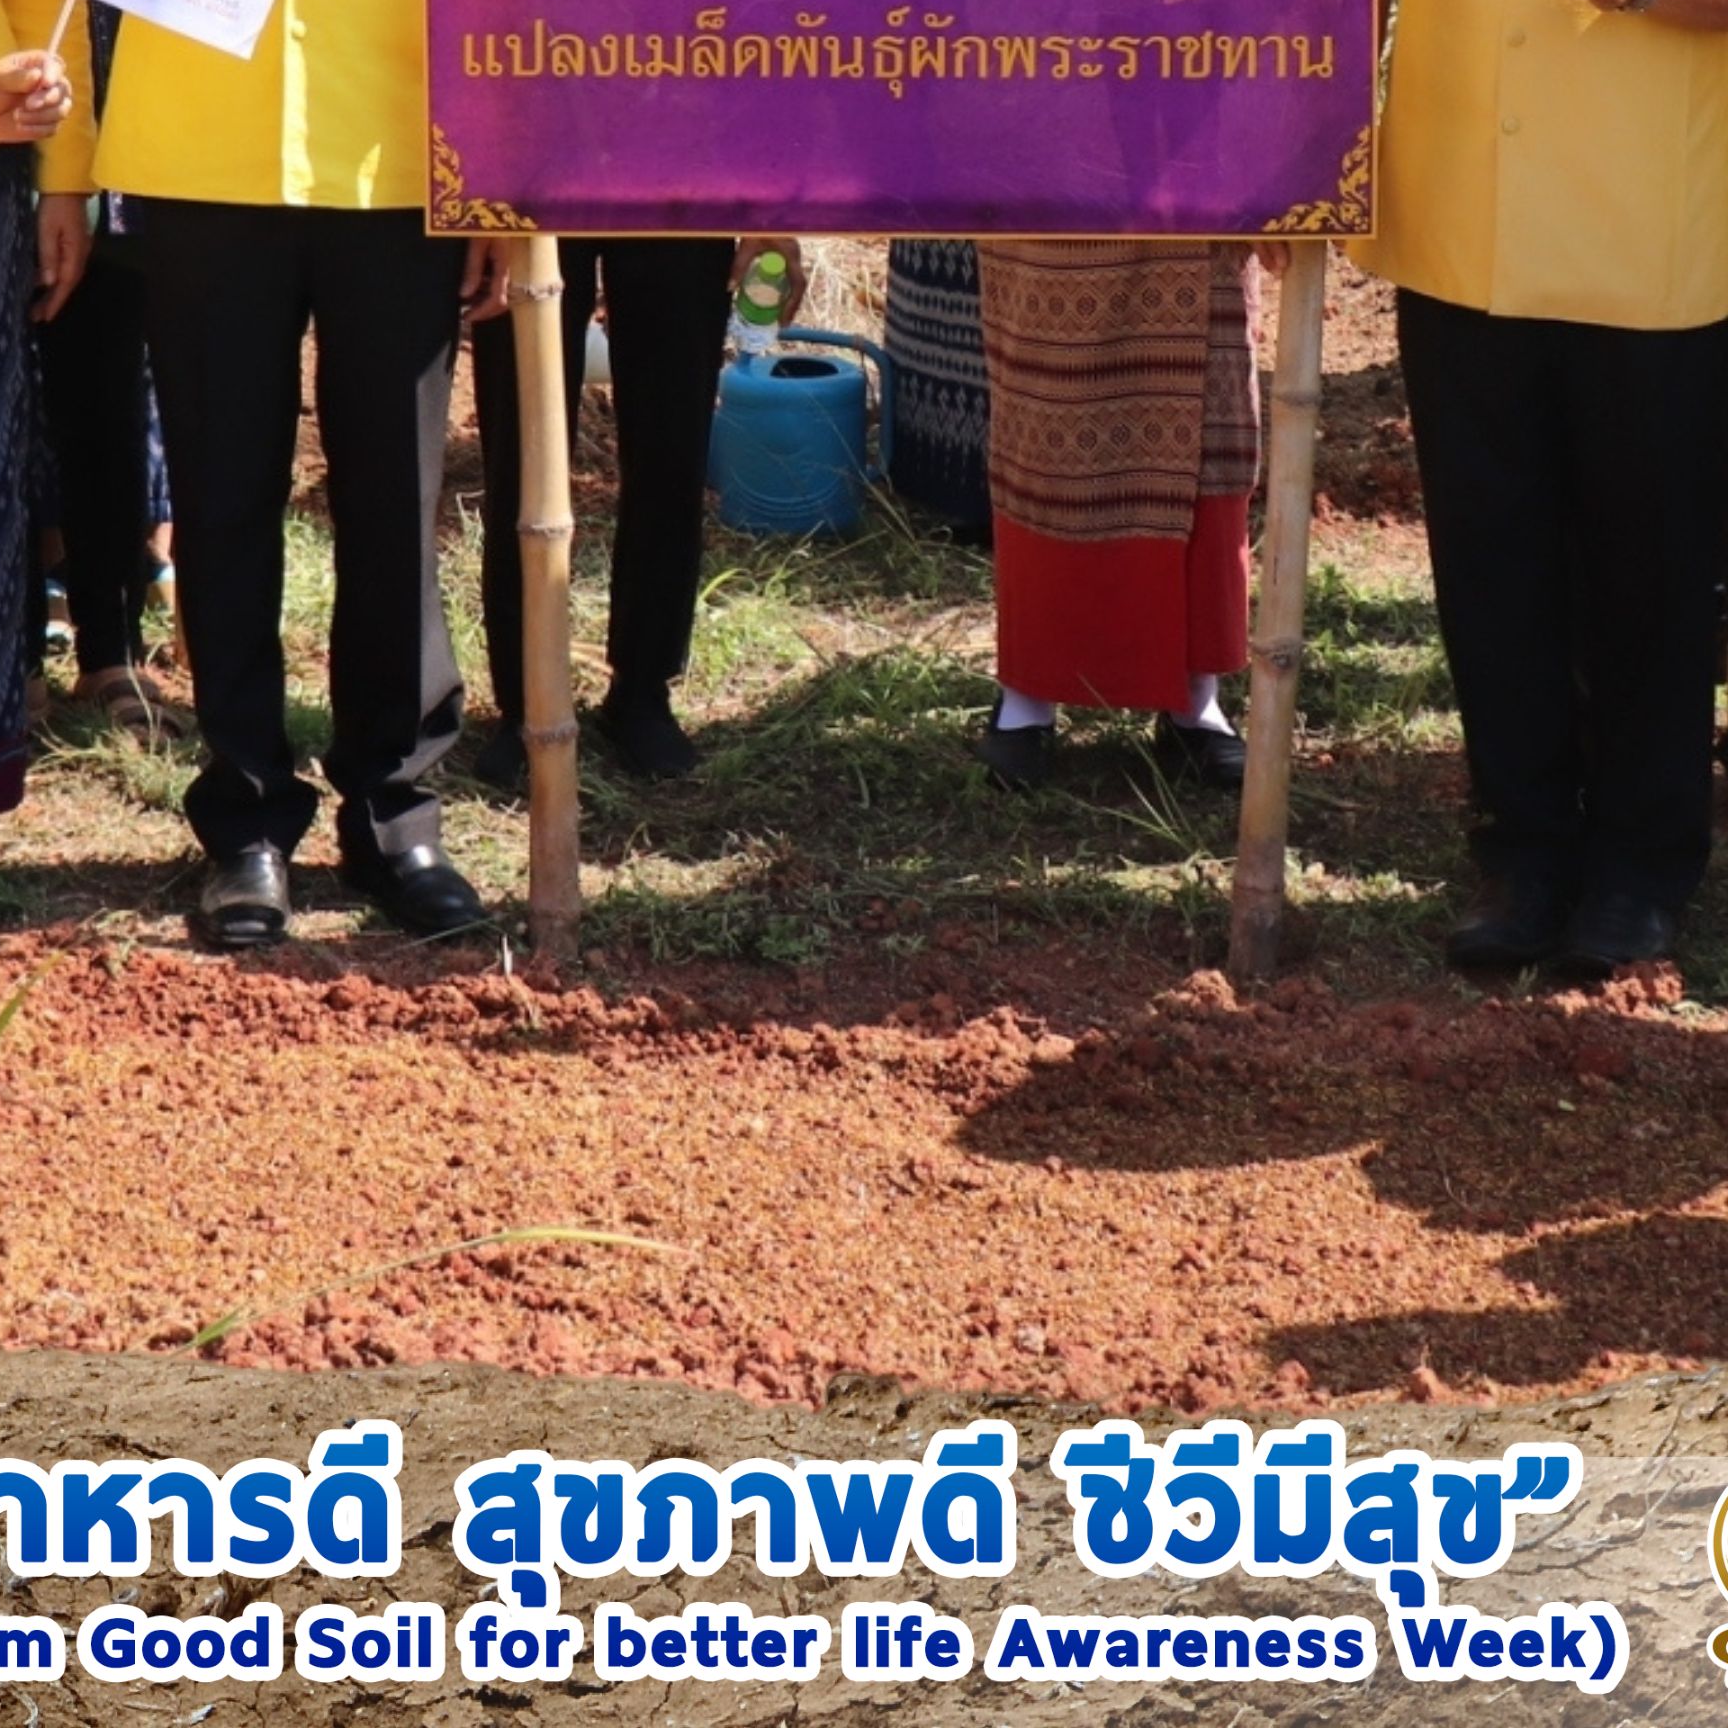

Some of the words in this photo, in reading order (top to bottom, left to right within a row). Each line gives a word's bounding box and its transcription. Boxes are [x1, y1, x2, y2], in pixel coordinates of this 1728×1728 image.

[462, 5, 1334, 99] แปลงเมล็ดพันธุ์ผักพระราชทาน
